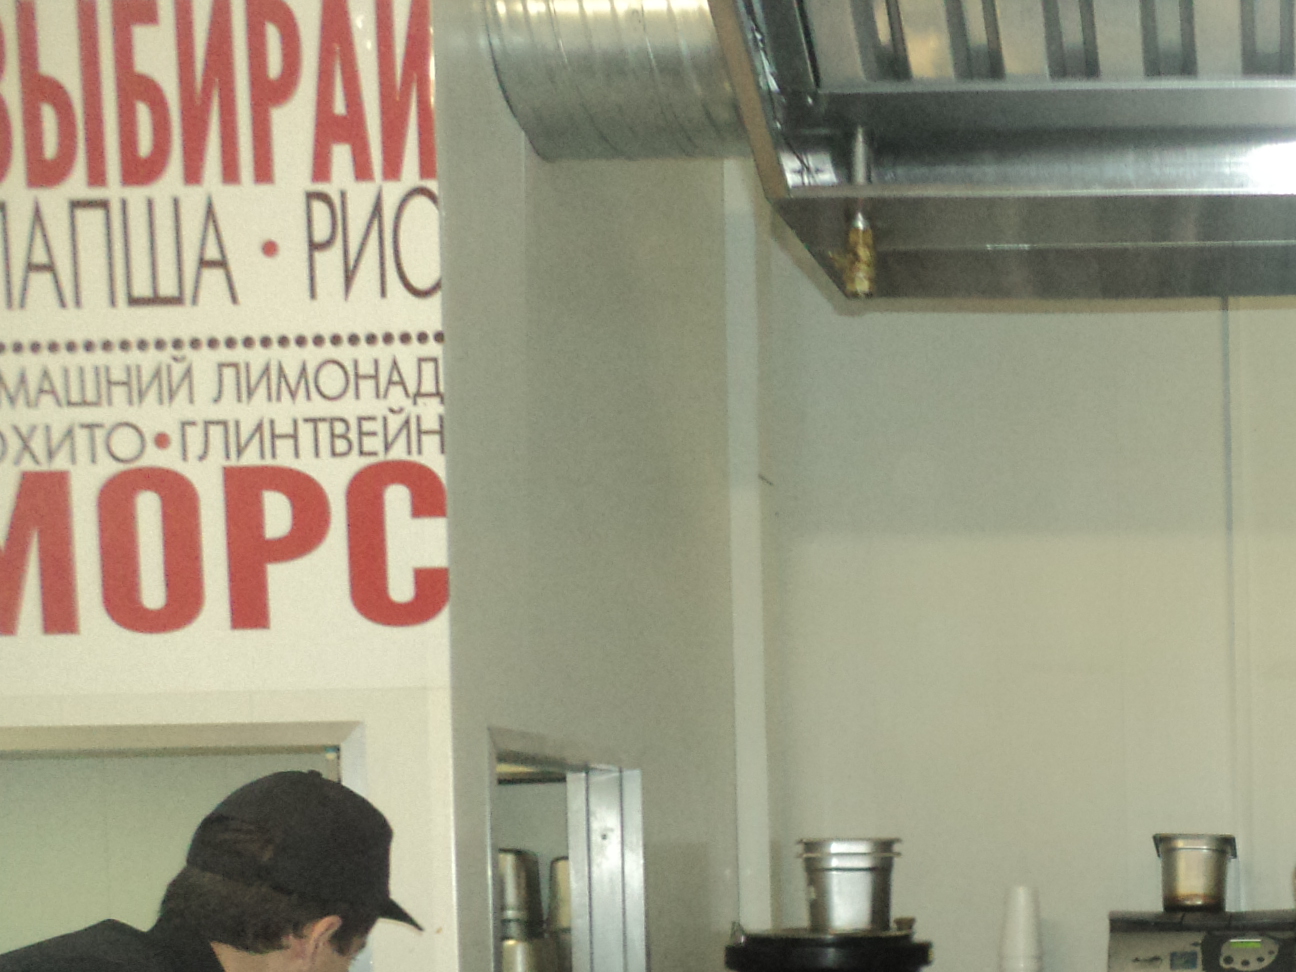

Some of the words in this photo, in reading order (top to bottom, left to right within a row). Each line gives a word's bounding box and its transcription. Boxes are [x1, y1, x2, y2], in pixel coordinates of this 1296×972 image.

[0, 195, 239, 309] АПША
[305, 184, 442, 301] РИС
[213, 356, 444, 405] ЛИМОНАД
[0, 420, 147, 466] ХИТО
[180, 407, 446, 463] ГЛИНТВЕЙН
